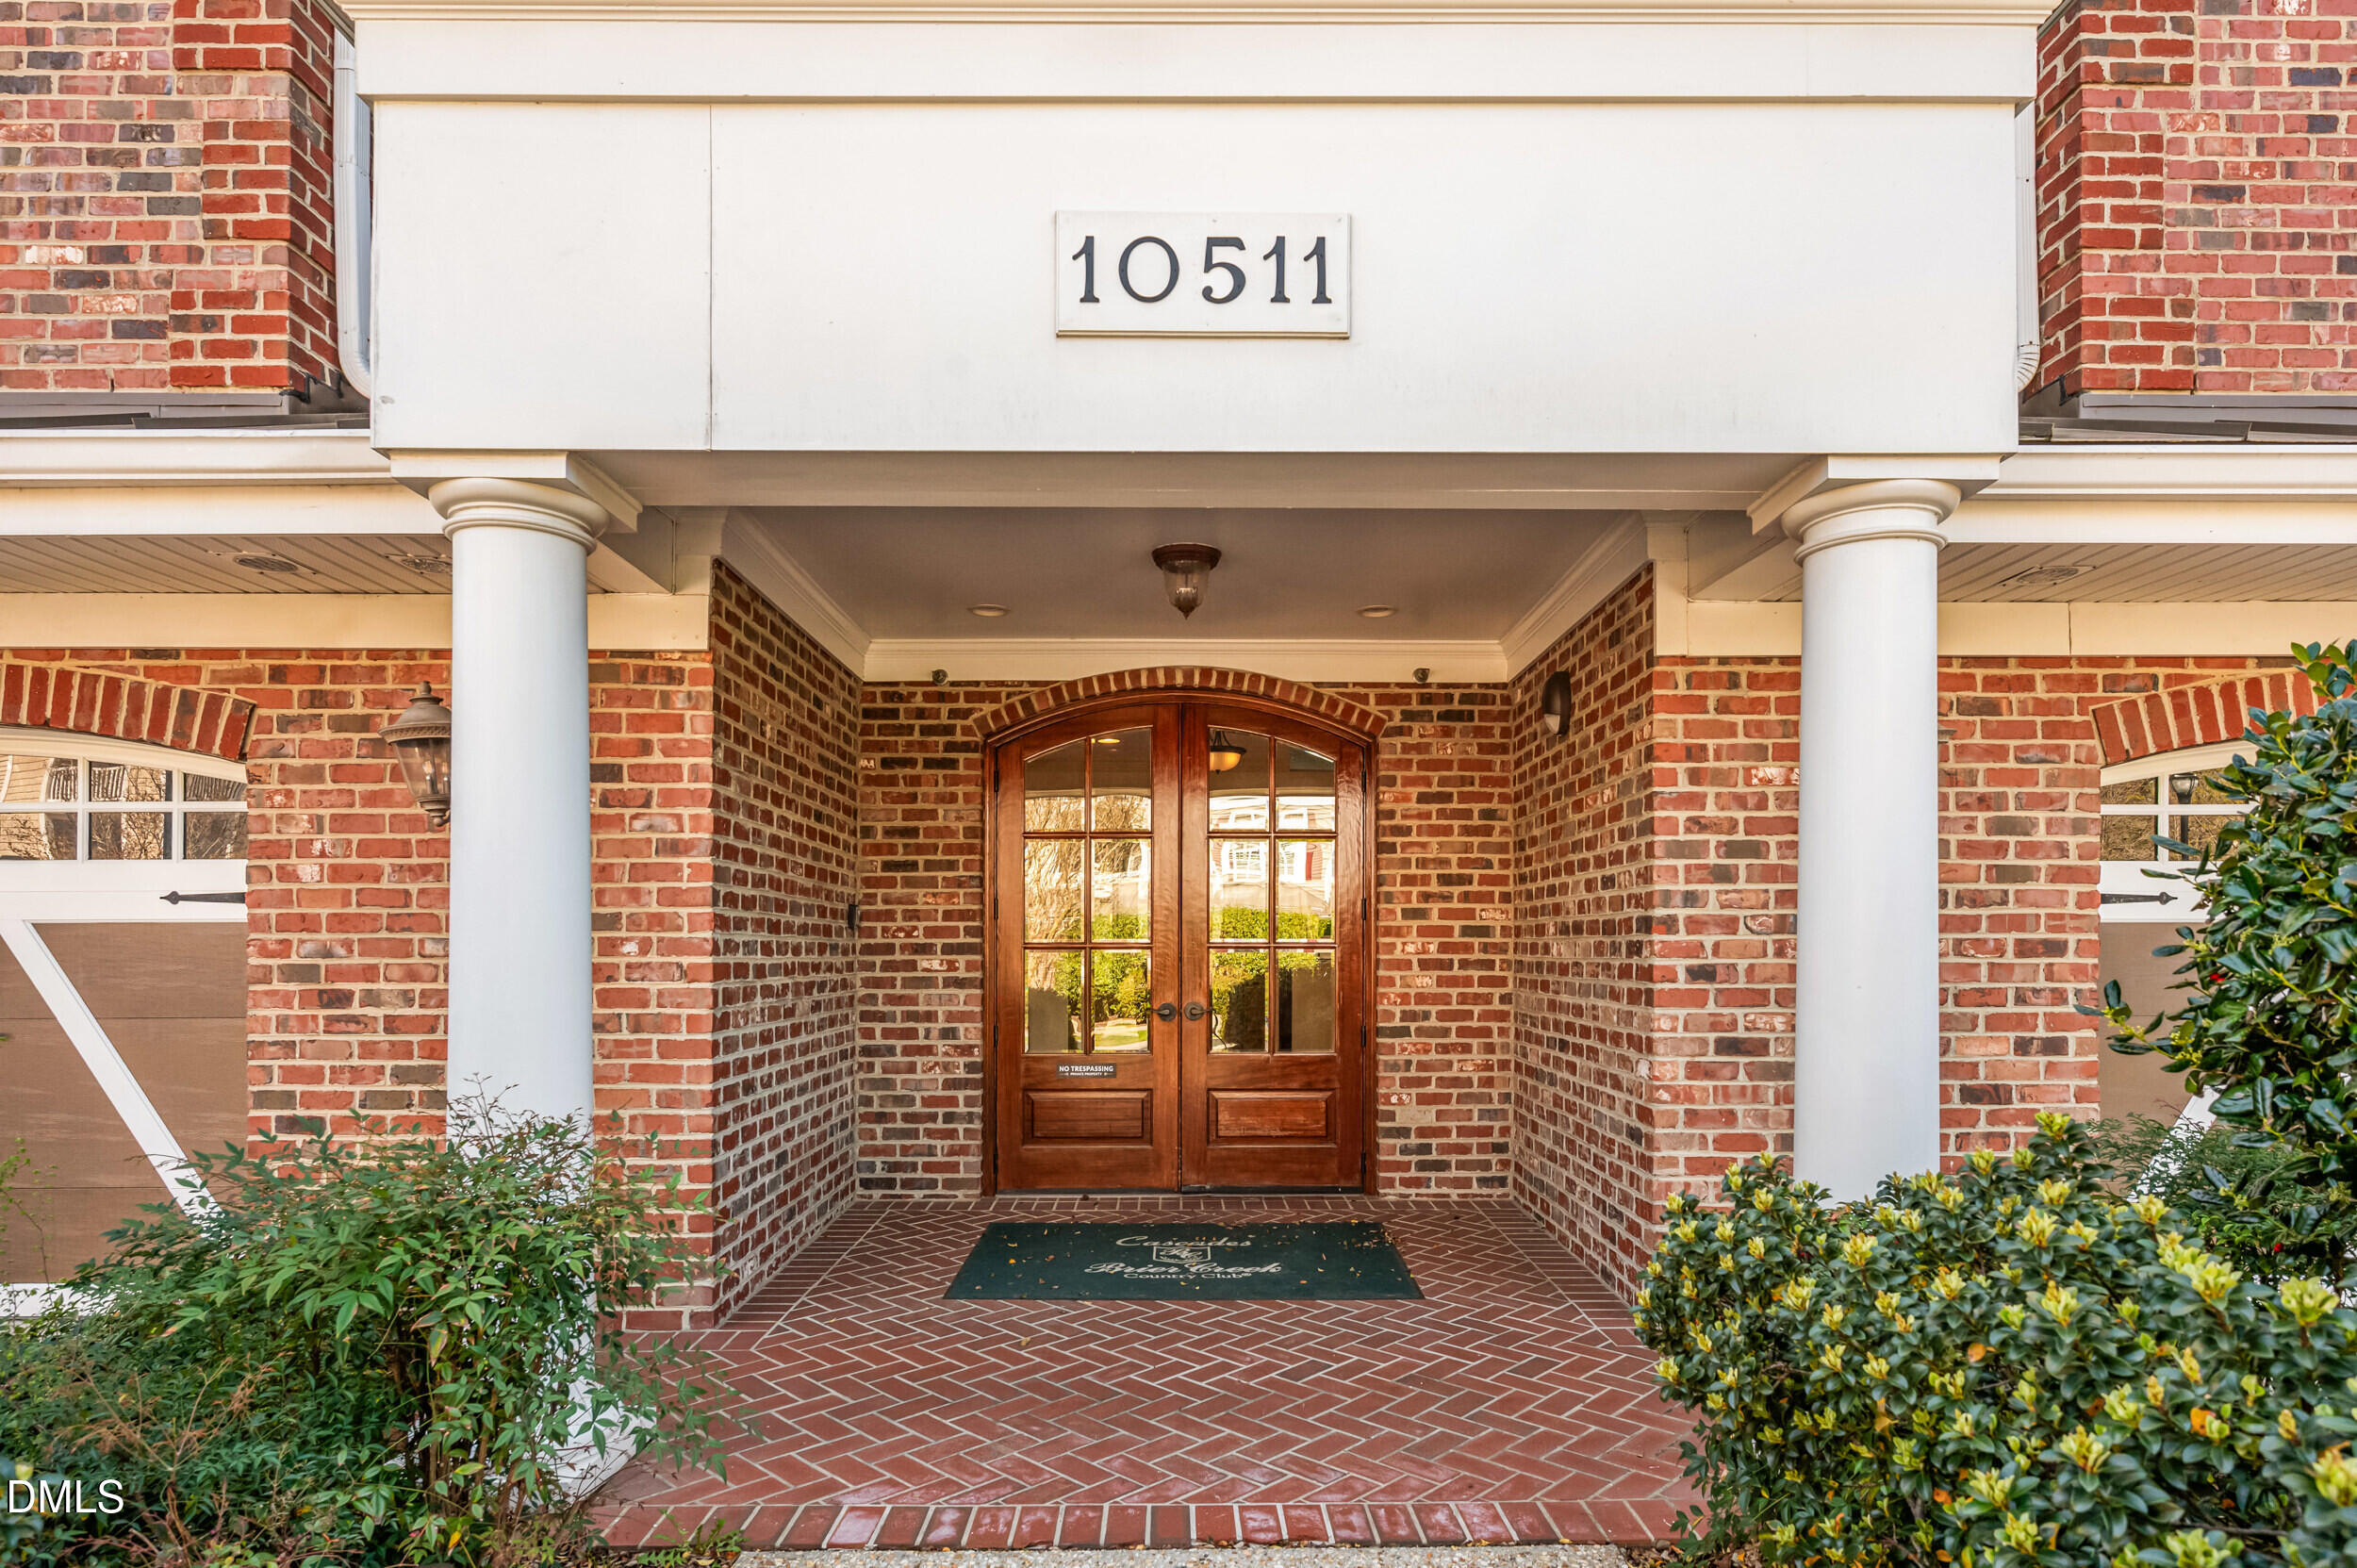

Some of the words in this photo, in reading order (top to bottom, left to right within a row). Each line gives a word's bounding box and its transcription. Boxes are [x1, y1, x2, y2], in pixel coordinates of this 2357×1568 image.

[1072, 236, 1332, 304] 10511
[1115, 1235, 1252, 1246] Cascades
[1084, 1262, 1181, 1274] Brier
[1184, 1262, 1282, 1274] Creek
